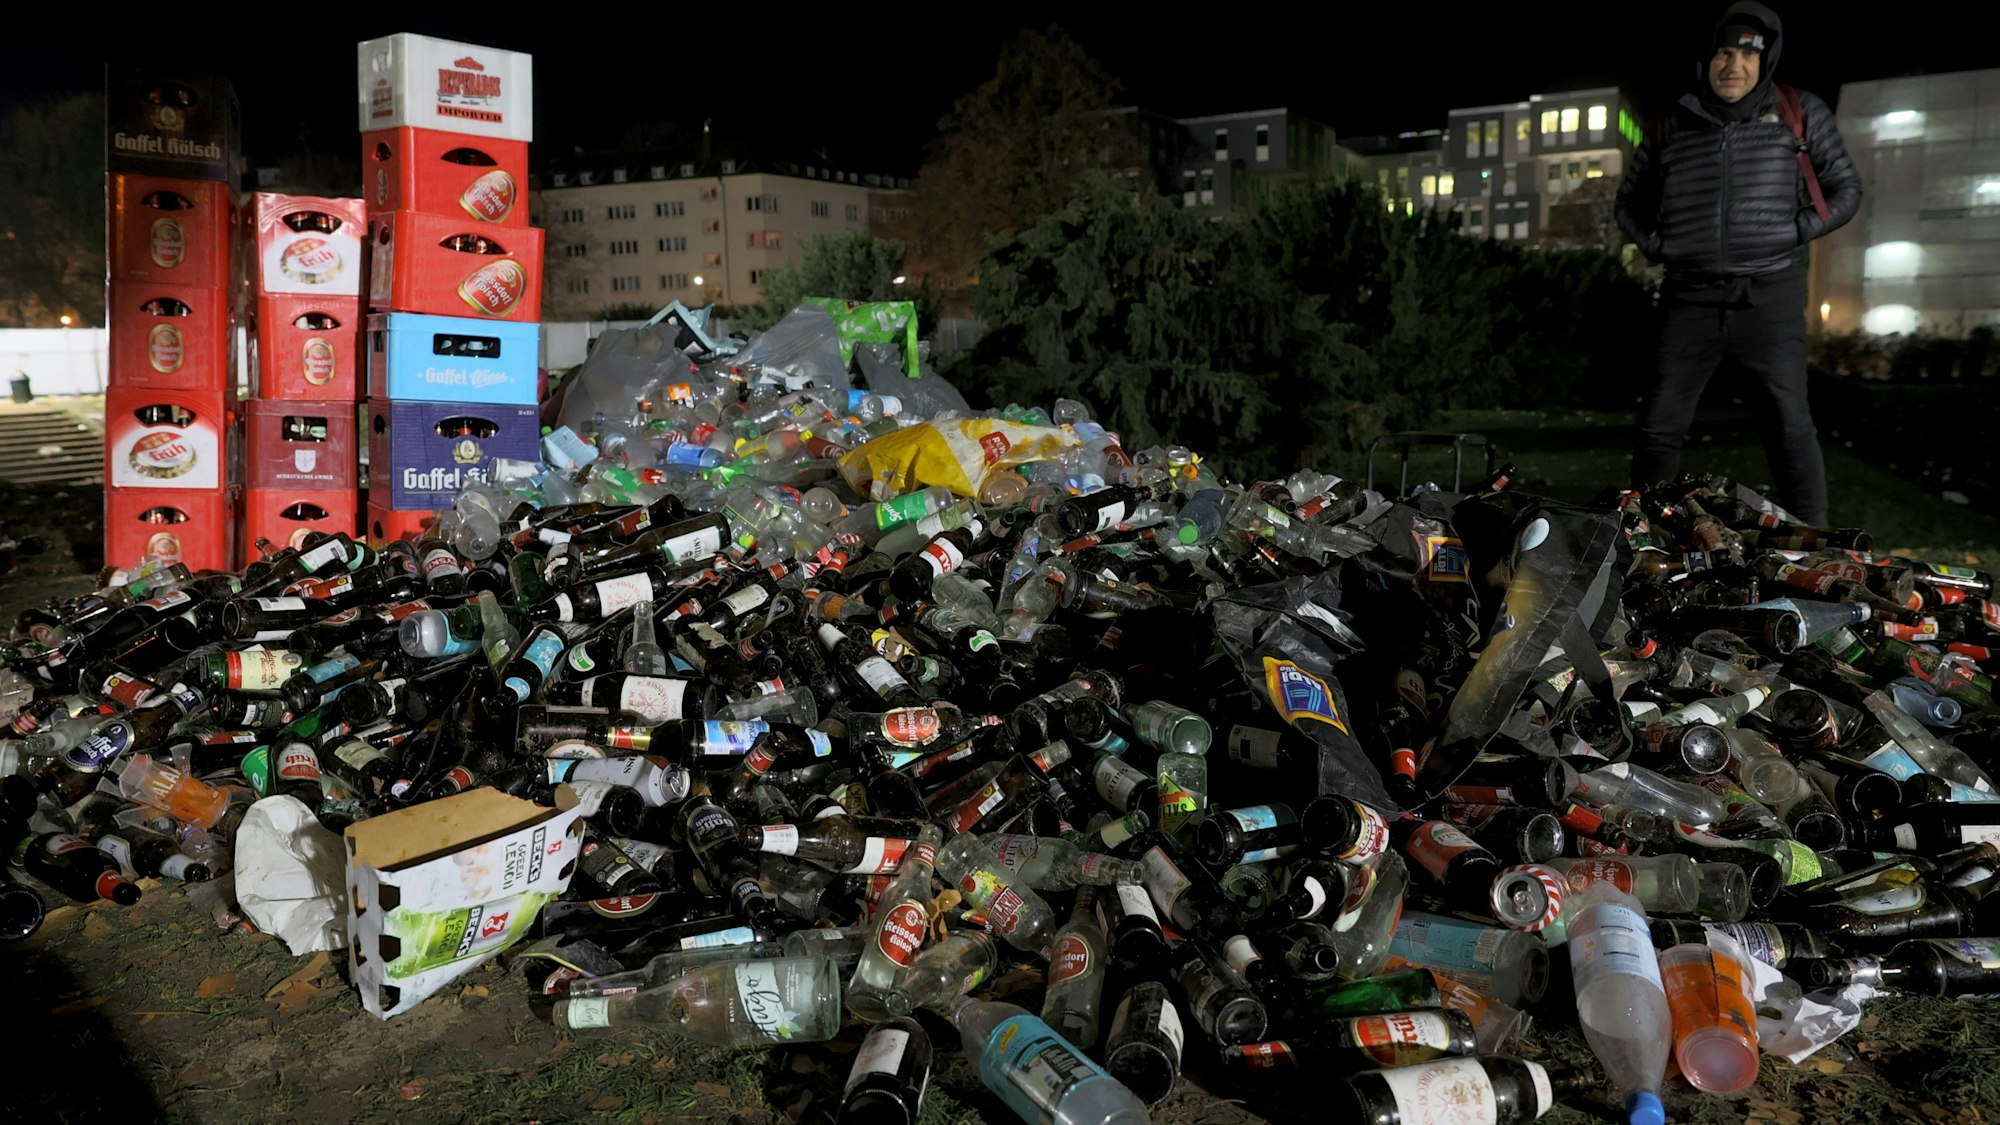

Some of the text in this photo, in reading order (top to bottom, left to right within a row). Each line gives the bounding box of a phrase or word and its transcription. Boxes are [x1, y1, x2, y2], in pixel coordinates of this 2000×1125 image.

[438, 69, 501, 98] DESPERADOS
[437, 106, 502, 122] IMPORTED
[114, 132, 221, 160] Gaffel Kölsch
[425, 367, 468, 385] Gaffel
[403, 467, 461, 491] Gaffel
[938, 550, 952, 575] TYS
[1281, 671, 1322, 691] ALDI
[694, 818, 735, 841] Gaffel
[502, 841, 517, 890] LEMON
[514, 843, 527, 880] GREEN
[747, 976, 783, 1041] Hugo
